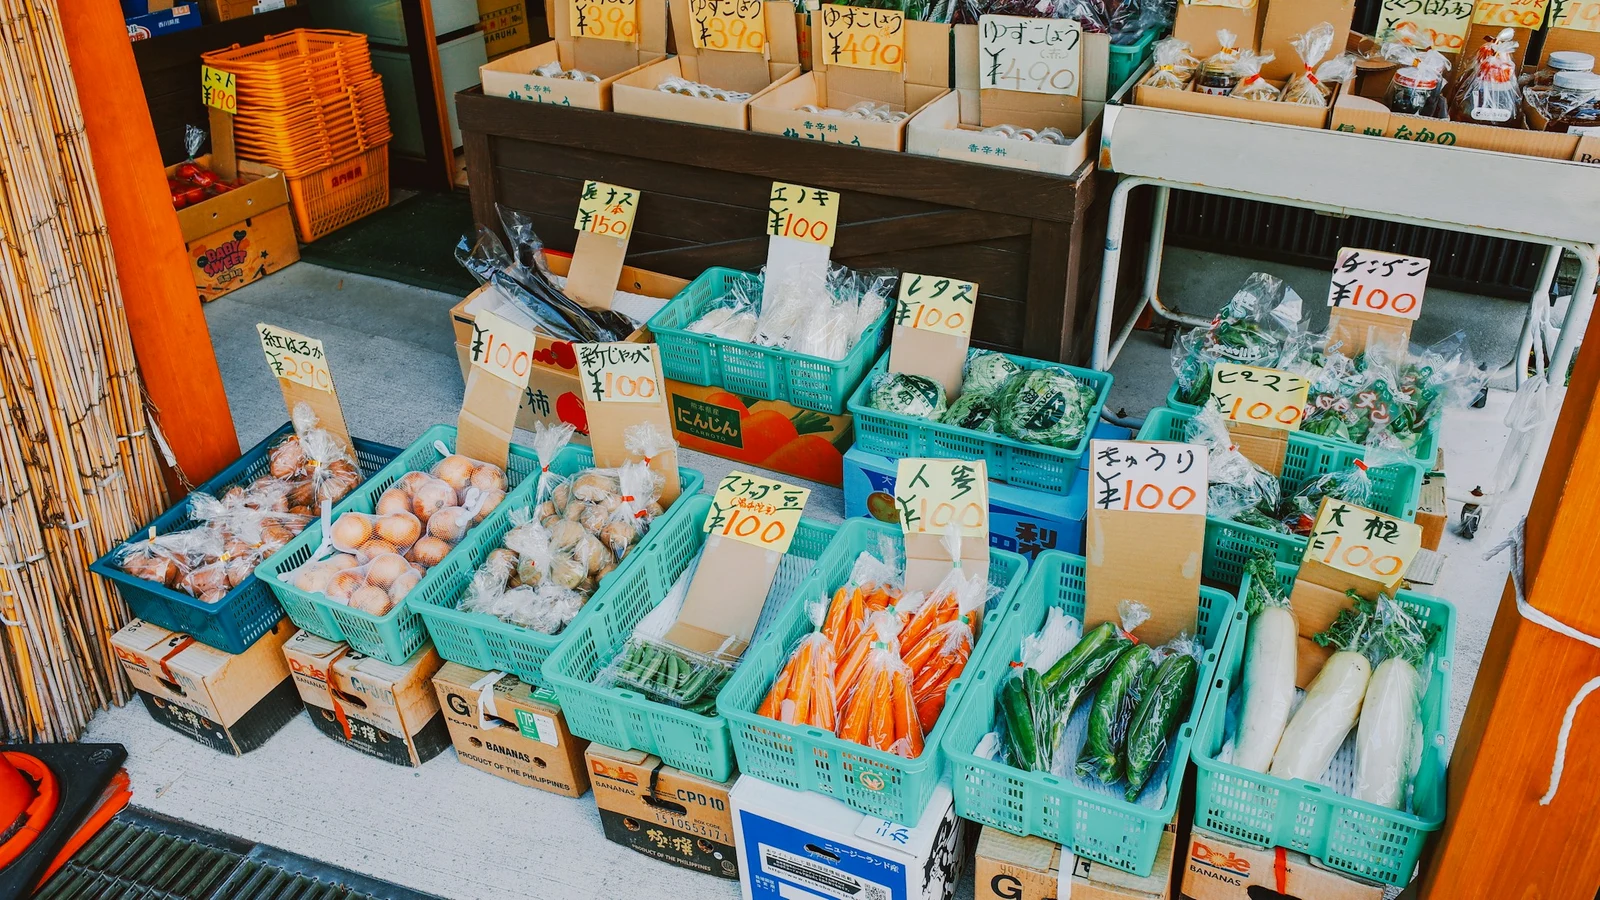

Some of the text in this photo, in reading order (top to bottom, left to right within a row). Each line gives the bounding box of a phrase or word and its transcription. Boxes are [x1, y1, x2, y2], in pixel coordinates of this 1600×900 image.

[576, 4, 636, 37] ¥390
[696, 16, 765, 48] ¥390
[823, 8, 902, 35] ゆずこしょう
[984, 20, 1080, 50] ゆずこしょう
[828, 31, 904, 65] ¥490
[204, 67, 233, 88] トマト
[984, 47, 1075, 90] ¥490
[202, 84, 236, 110] ¥190
[803, 121, 838, 132] 香辛料
[968, 143, 1007, 157] 香辛料
[581, 183, 633, 206] 長ナス
[770, 187, 830, 206] エノキ
[579, 208, 628, 234] ¥150
[769, 207, 828, 241] ¥100
[203, 250, 247, 278] SWEET
[205, 240, 240, 263] BABY
[907, 275, 974, 304] レタス
[1331, 279, 1417, 313] ¥100
[894, 300, 965, 329] ¥100
[472, 322, 528, 377] ¥100
[579, 344, 651, 370] 新じゃが
[266, 350, 330, 388] ¥290
[1217, 370, 1305, 392] ピーマン
[588, 369, 655, 402] ¥100
[525, 386, 550, 418] 柿
[1210, 392, 1301, 425] ¥100
[677, 406, 738, 437] にんじん
[689, 427, 726, 441] CARROTO
[1097, 446, 1195, 474] きゅうり
[720, 475, 804, 511] スナップ豆
[908, 463, 976, 500] 人参
[1096, 471, 1197, 511] ¥100
[708, 501, 786, 544] ¥100
[897, 494, 984, 532] ¥100
[1326, 504, 1401, 545] 大根
[1014, 521, 1058, 561] 梨
[1312, 530, 1403, 576] ¥100
[289, 658, 326, 681] Dole
[295, 676, 328, 692] BANANAS
[517, 710, 534, 727] 17P
[485, 741, 531, 764] BANANAS
[457, 750, 570, 791] PRODUCT OF THE PHILIPPINES
[590, 760, 639, 783] Dole
[595, 780, 636, 797] BANANAS
[646, 828, 693, 856] 極撰
[631, 843, 712, 872] PRODUCT OF THE PHILIPPINES
[824, 843, 900, 873] ニュージーランド産
[1191, 841, 1251, 873] Dole
[991, 874, 1022, 900] G
[1189, 864, 1242, 887] BANANAS
